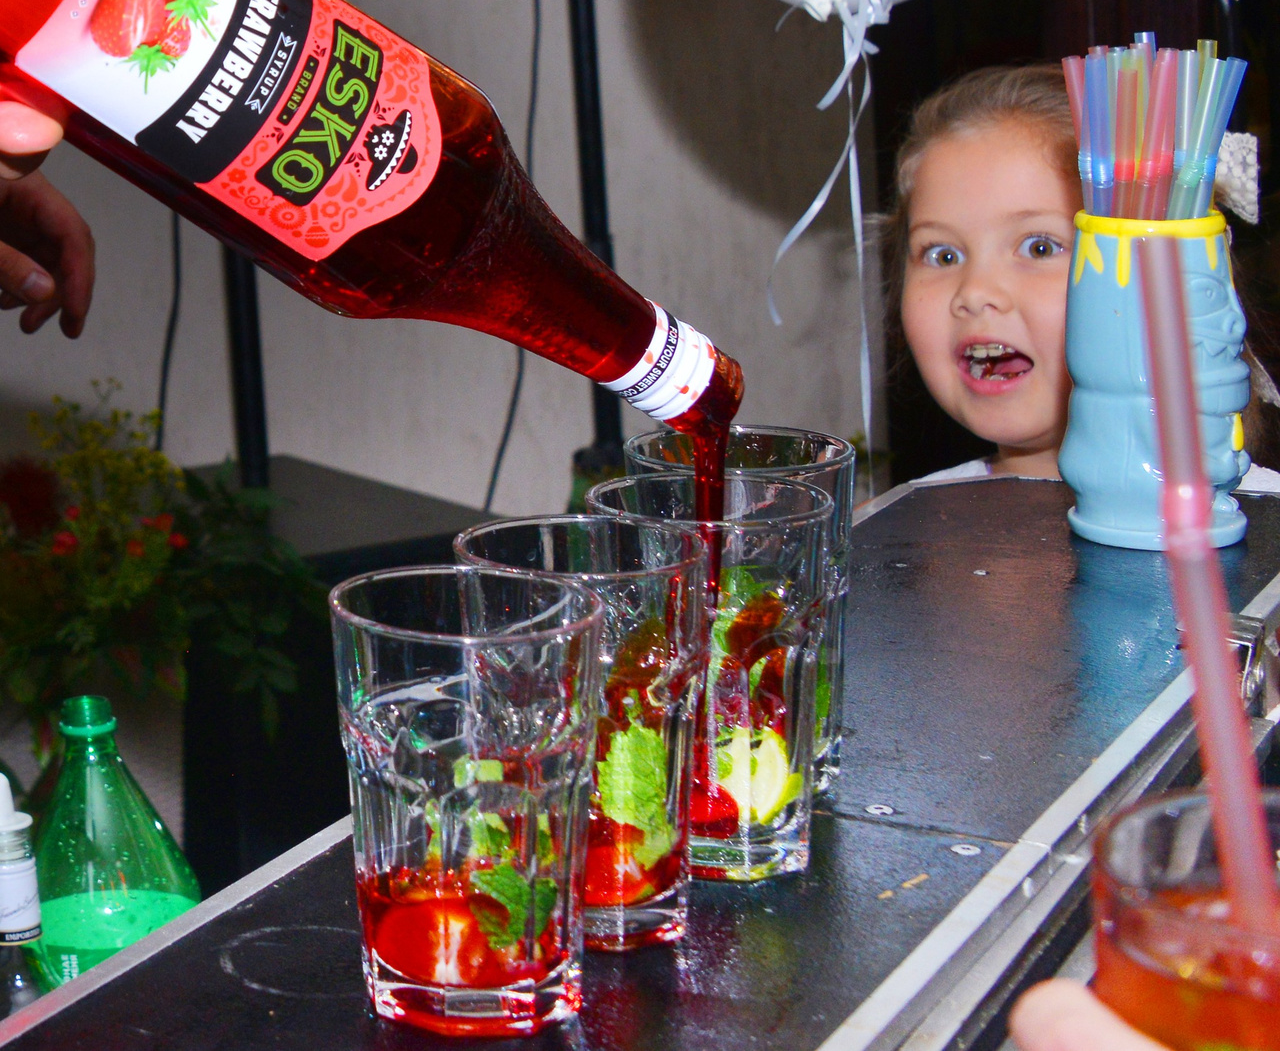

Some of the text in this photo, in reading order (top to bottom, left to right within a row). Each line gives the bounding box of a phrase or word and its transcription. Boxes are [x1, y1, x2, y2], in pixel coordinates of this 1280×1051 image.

[260, 50, 288, 97] SYRUP
[287, 70, 313, 110] BRAND
[272, 26, 379, 193] ESKO
[668, 326, 679, 345] FOR
[656, 344, 675, 369] YOUR
[635, 367, 662, 392] SWEET
